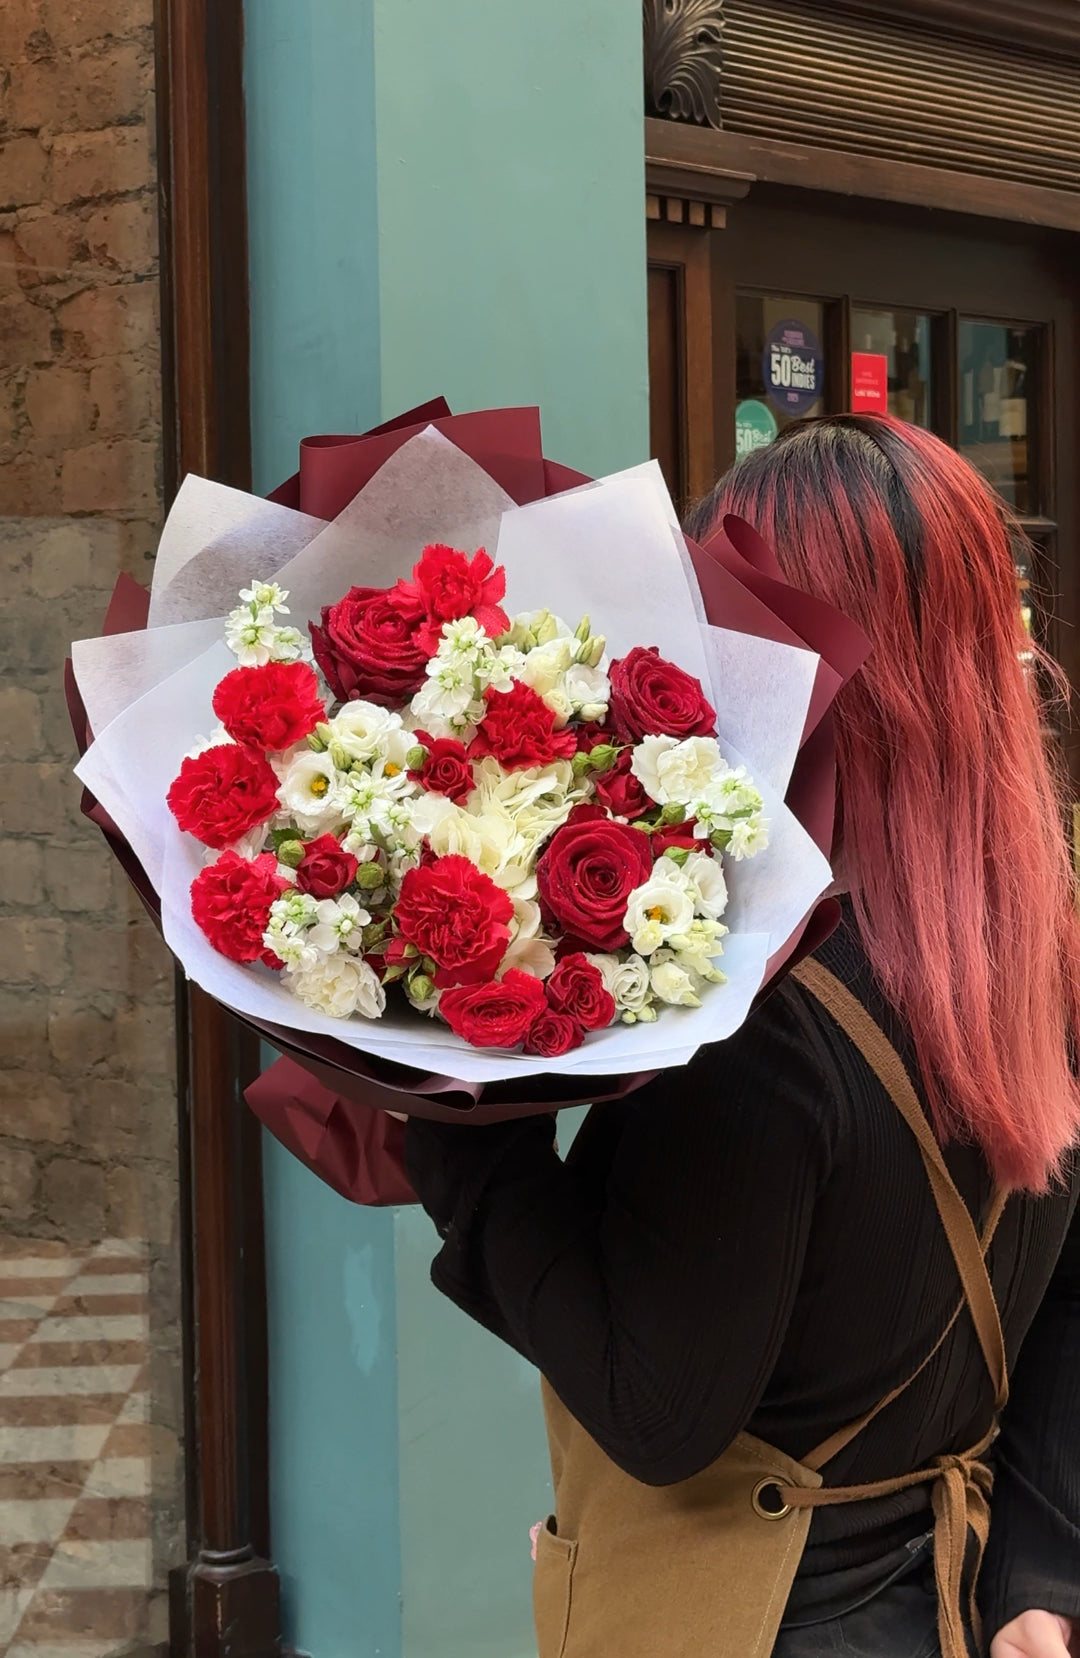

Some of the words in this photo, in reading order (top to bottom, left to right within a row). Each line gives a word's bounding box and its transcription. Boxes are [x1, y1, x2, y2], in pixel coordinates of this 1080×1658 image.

[771, 353, 791, 387] 50
[791, 355, 815, 373] Best
[791, 372, 816, 390] INDIES
[736, 428, 752, 453] 50
